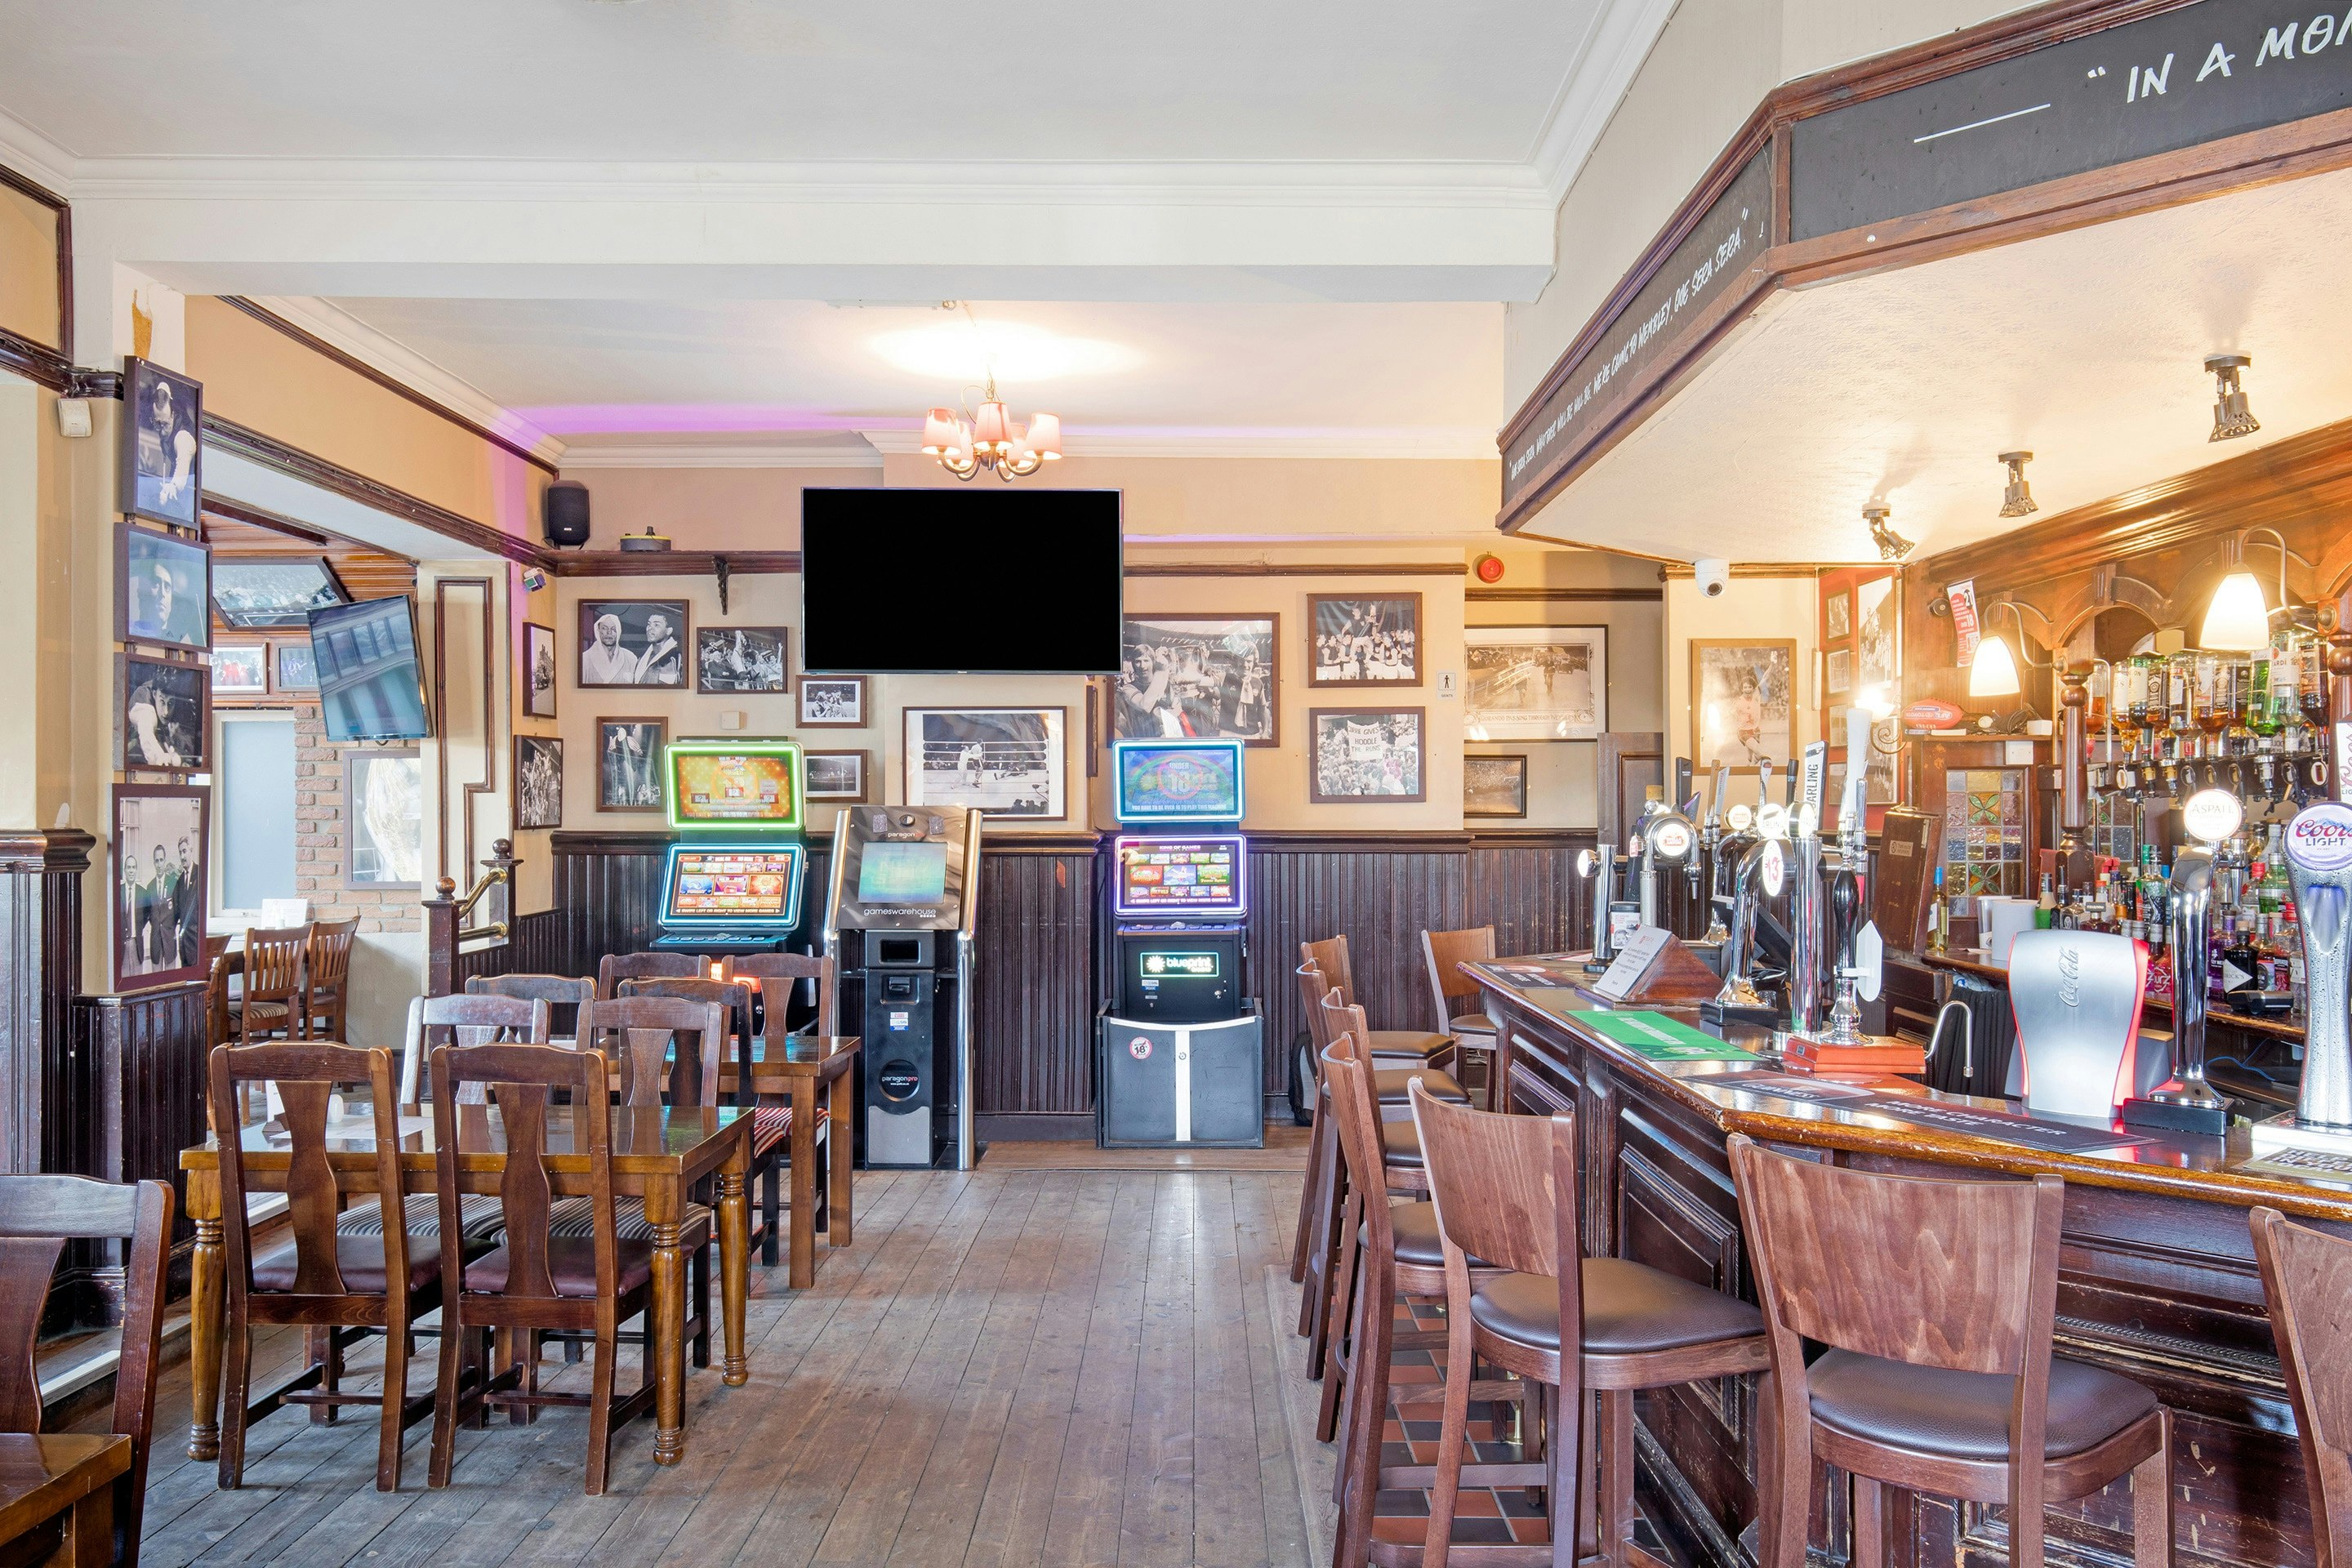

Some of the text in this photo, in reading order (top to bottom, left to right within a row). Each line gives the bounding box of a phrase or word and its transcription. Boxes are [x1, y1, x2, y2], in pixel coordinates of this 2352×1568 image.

[2127, 53, 2175, 104] IN
[2196, 42, 2236, 82] A
[2255, 7, 2352, 68] MO
[1674, 279, 1690, 313] QUE
[1691, 257, 1713, 297] SERA
[1354, 737, 1378, 746] HODDLE
[2305, 838, 2347, 847] LIGHT
[1768, 856, 1780, 882] 13
[863, 908, 937, 916] gameswarehouse
[1166, 957, 1213, 969] blueprint
[2058, 946, 2080, 1007] Coca-Cola
[1864, 1102, 1984, 1127] MORE TASTE
[1886, 1100, 2068, 1136] MORE CHARACTER
